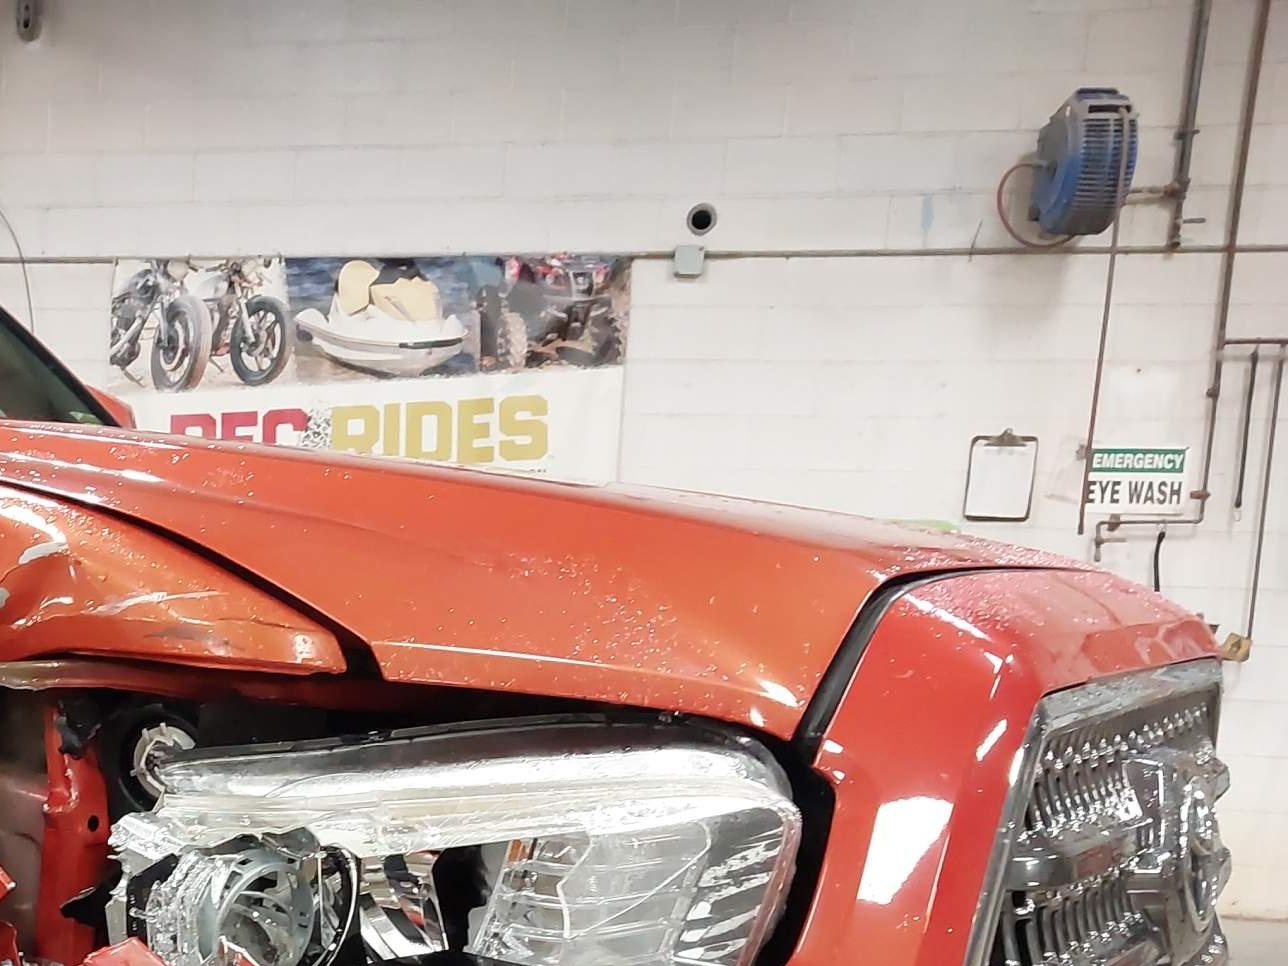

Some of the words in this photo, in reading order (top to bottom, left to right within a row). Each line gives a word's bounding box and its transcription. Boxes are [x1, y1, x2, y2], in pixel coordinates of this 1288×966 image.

[332, 395, 549, 465] RIDES
[1092, 453, 1184, 469] EMERGENCY
[1084, 480, 1121, 504] EYE
[1128, 480, 1182, 505] WASH
